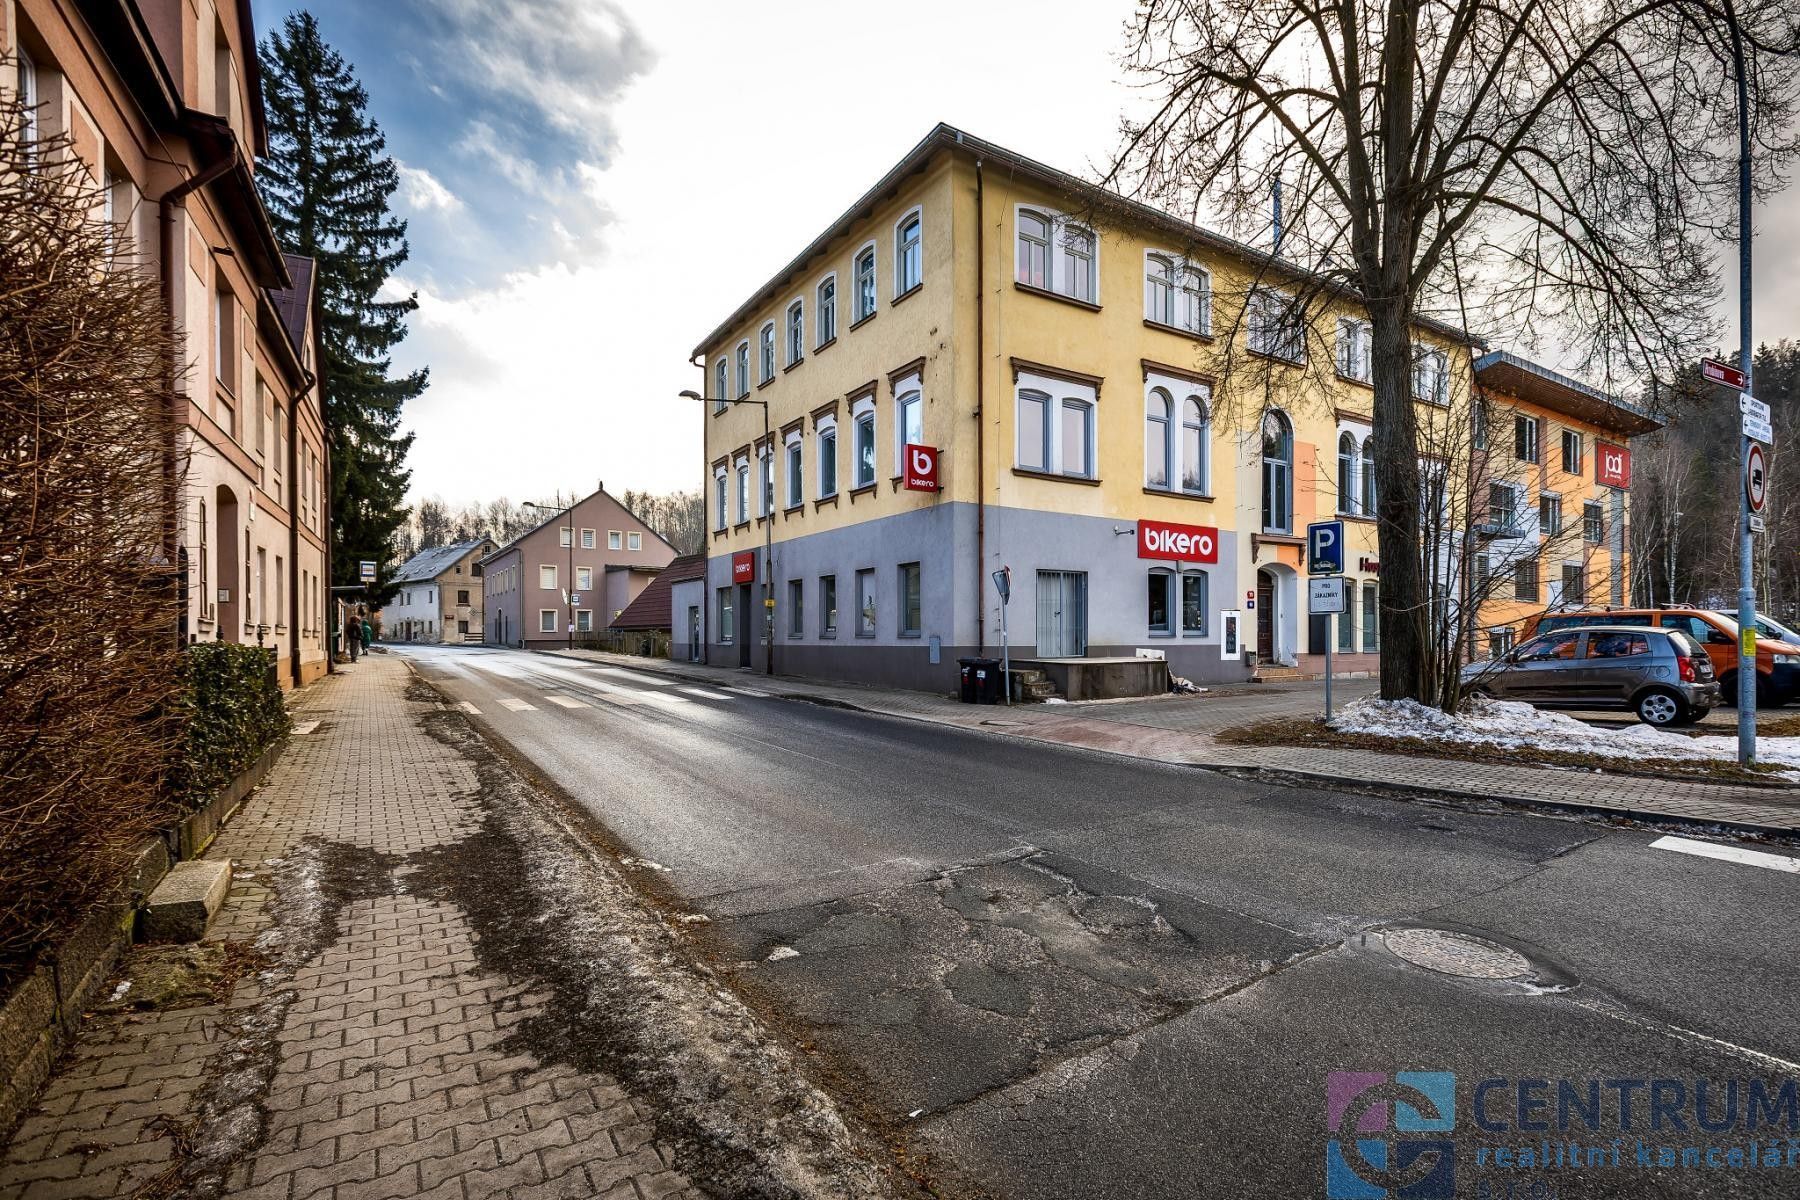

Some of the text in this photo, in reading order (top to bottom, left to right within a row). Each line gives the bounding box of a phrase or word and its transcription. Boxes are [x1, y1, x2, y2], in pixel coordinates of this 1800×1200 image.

[913, 449, 932, 475] b
[911, 478, 934, 488] bikero
[1144, 527, 1213, 556] bikero
[1315, 529, 1335, 558] P
